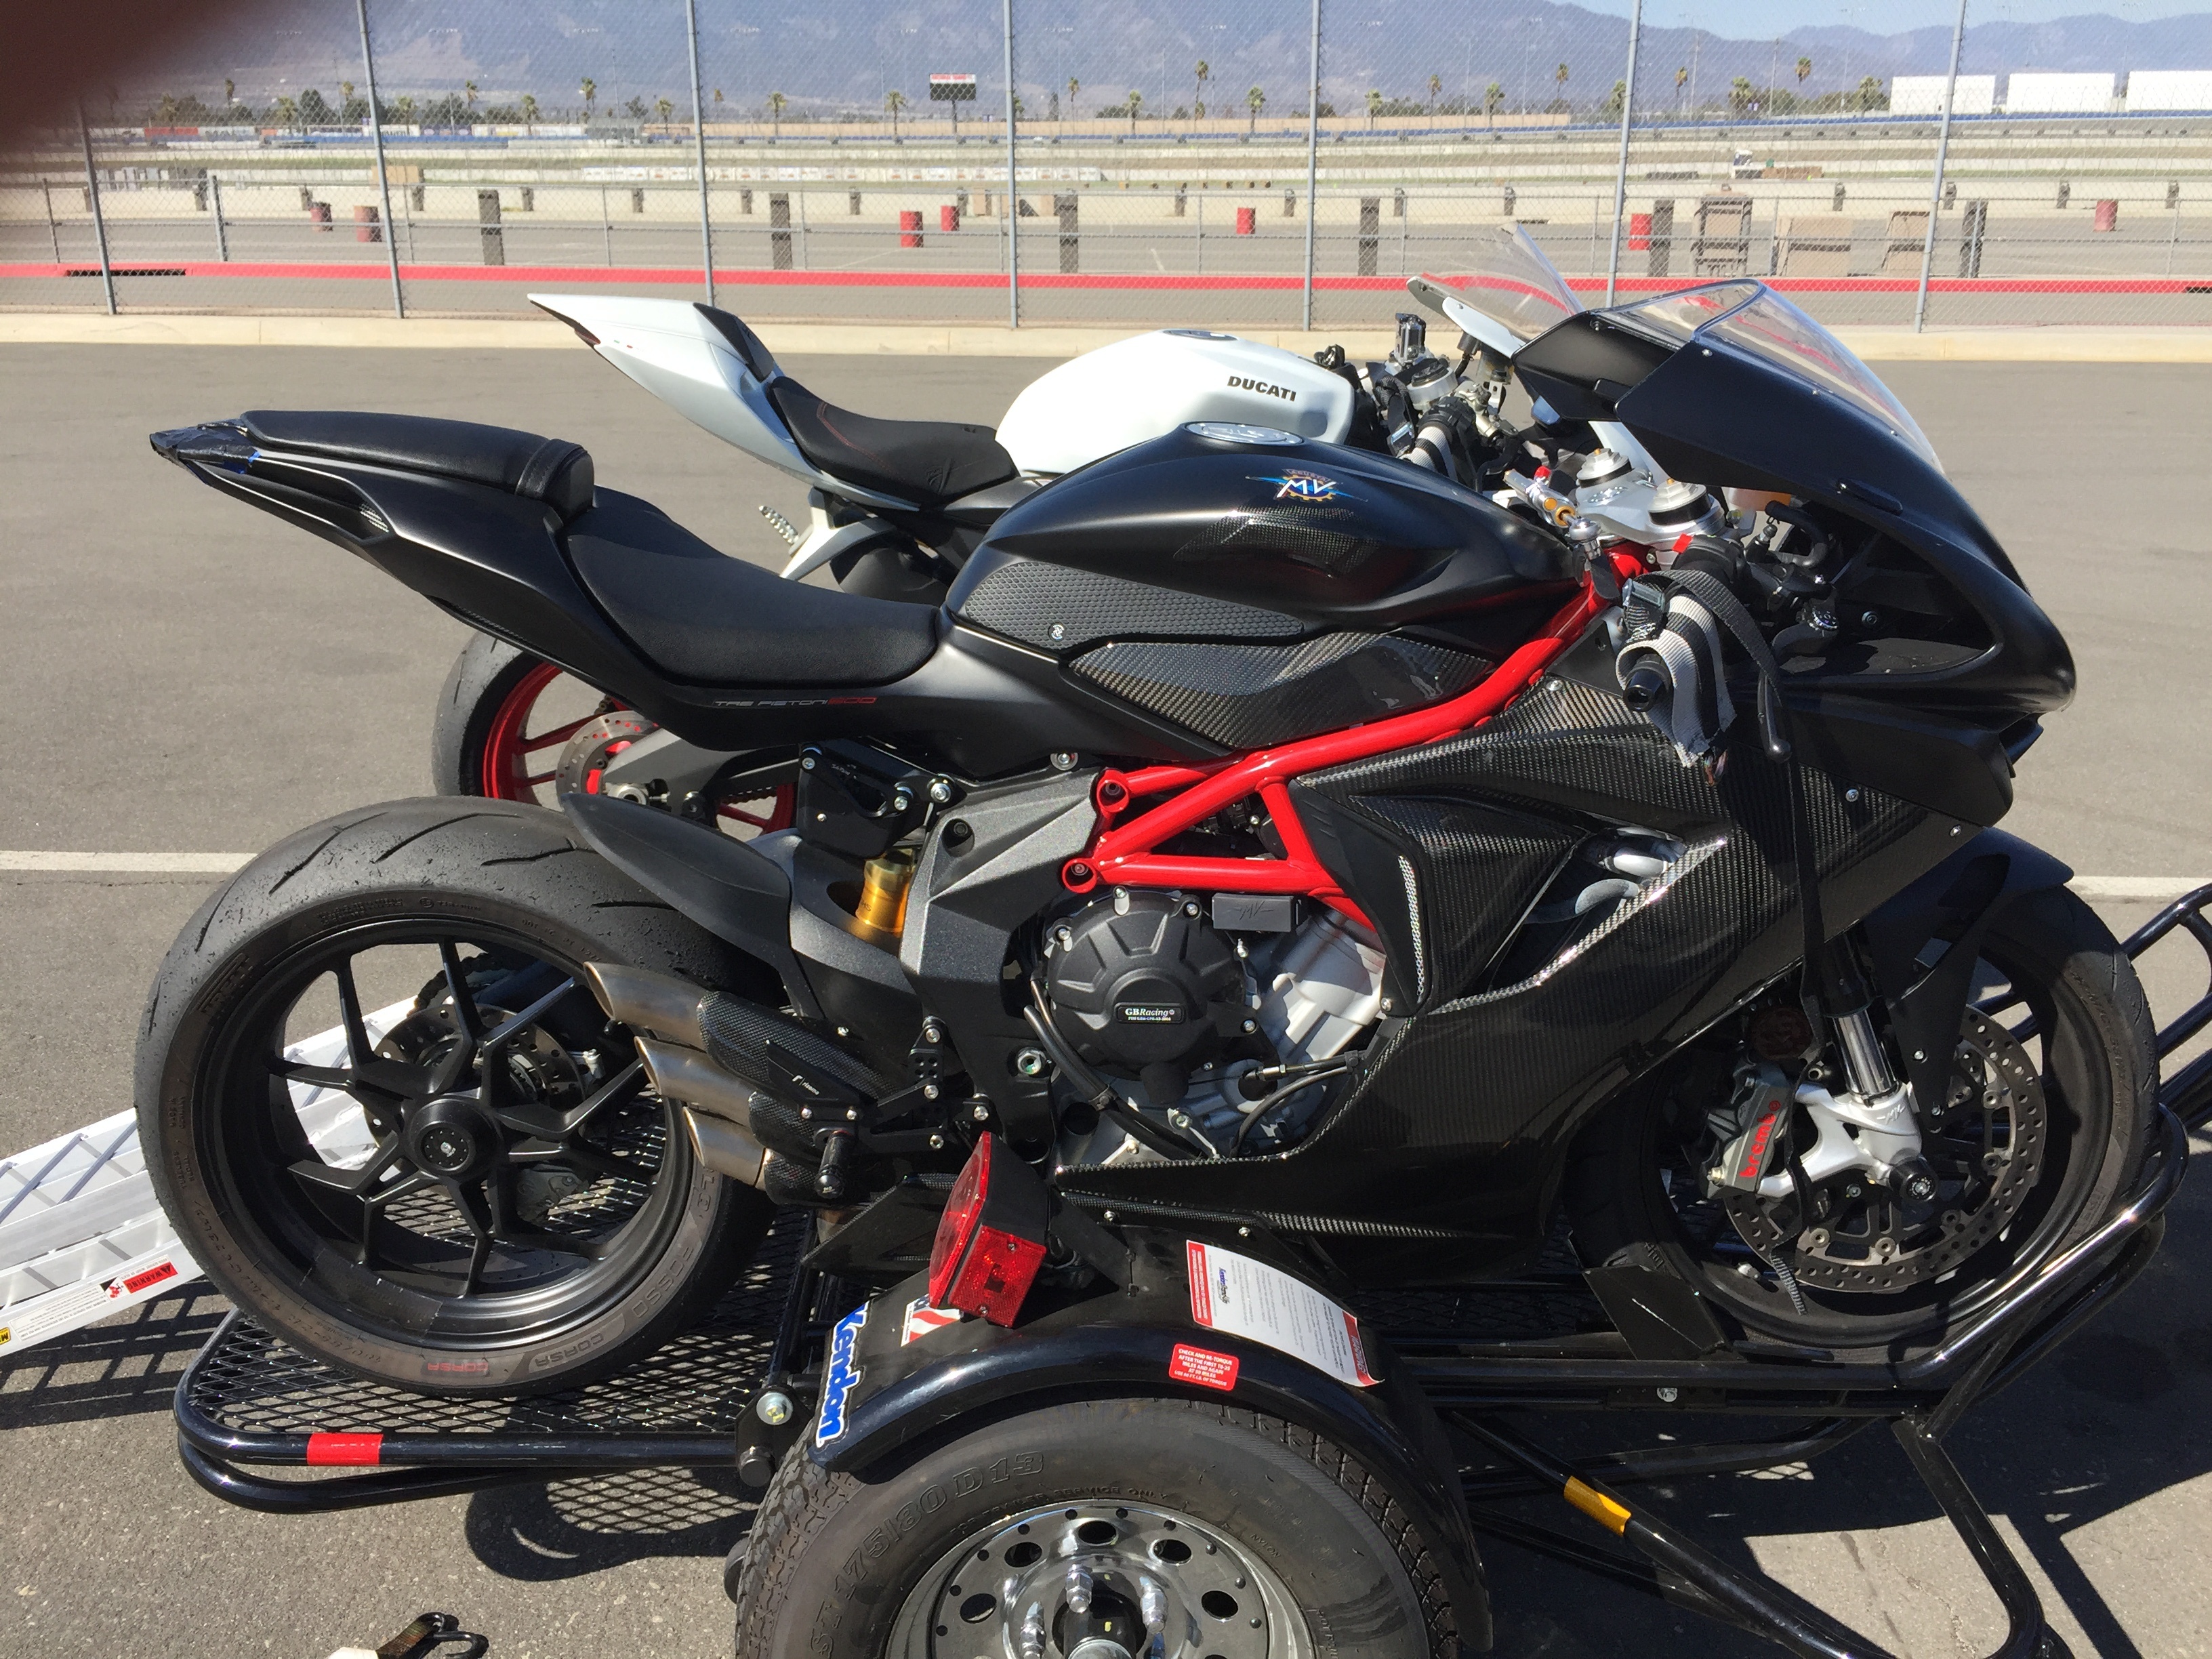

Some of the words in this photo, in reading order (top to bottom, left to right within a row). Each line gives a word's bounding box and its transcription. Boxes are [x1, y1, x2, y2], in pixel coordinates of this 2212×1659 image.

[1227, 375, 1297, 402] DUCATI
[1275, 478, 1337, 499] MV
[757, 699, 829, 707] PISTONI
[1125, 1008, 1169, 1018] GBRacing
[1739, 1099, 1782, 1179] brembo
[125, 1269, 164, 1290] WARNING
[535, 1332, 605, 1368] CORSA
[1177, 1347, 1195, 1357] CHECK
[427, 1362, 489, 1373] CORSA
[1178, 1353, 1193, 1362] AFTER
[1203, 1359, 1216, 1368] FIRST
[1181, 1360, 1196, 1368] MILES
[1208, 1367, 1224, 1375] AGAIN
[817, 1301, 871, 1444] Kendon
[1201, 1370, 1216, 1378] MILES
[1052, 1486, 1121, 1498] SERVICE
[1128, 1487, 1169, 1500] ONLY
[1250, 1532, 1282, 1559] NYLON
